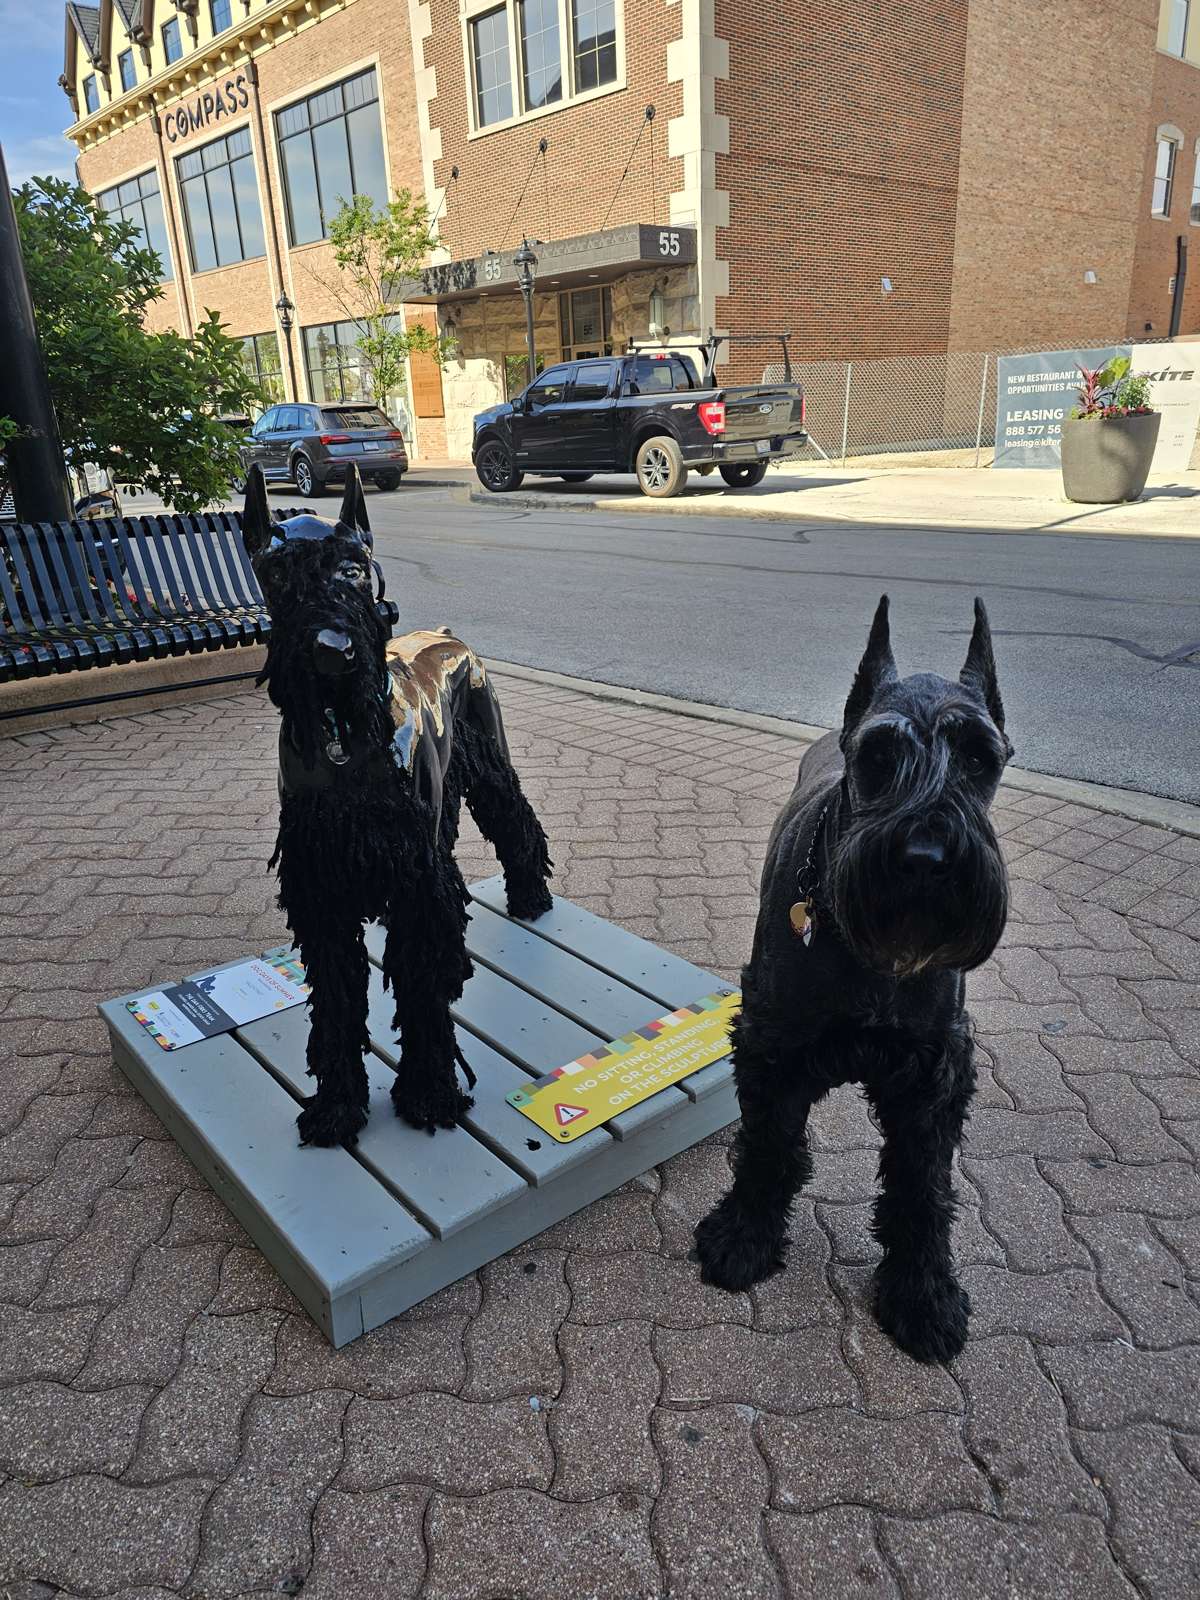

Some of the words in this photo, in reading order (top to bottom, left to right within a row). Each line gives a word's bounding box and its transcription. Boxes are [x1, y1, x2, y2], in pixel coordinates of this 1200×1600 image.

[165, 75, 248, 142] COMPASS
[659, 232, 680, 256] 55
[486, 260, 501, 280] 55
[1008, 375, 1025, 384] NEW
[1027, 371, 1075, 382] RESTAURANT
[1150, 366, 1195, 381] KITE
[1008, 383, 1065, 394] OPPORTUNITIES
[1007, 409, 1063, 422] LEASING
[1006, 426, 1024, 436] 888
[1027, 426, 1044, 434] 577
[620, 1070, 643, 1084] OR
[642, 1039, 704, 1073] CLIMBING
[573, 1080, 598, 1094] NO
[608, 1090, 633, 1105] ON
[630, 1076, 663, 1094] THE
